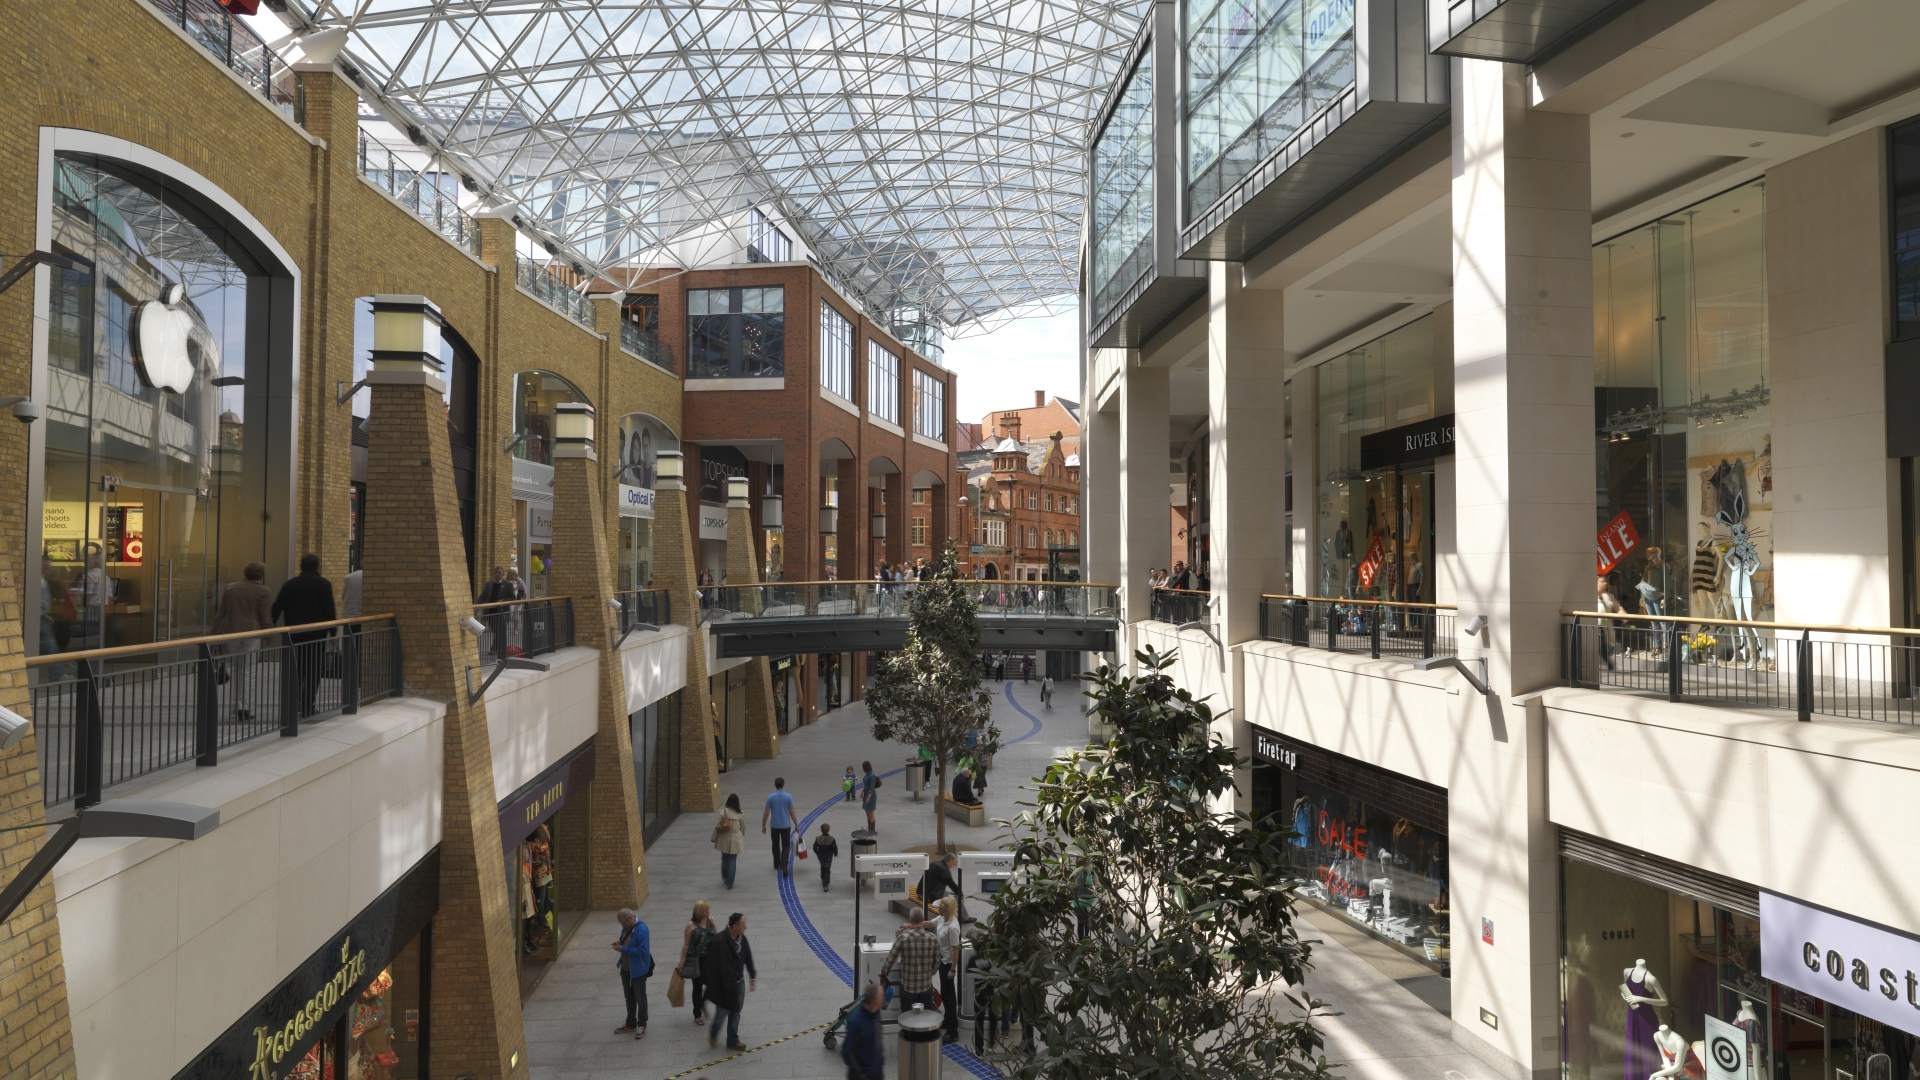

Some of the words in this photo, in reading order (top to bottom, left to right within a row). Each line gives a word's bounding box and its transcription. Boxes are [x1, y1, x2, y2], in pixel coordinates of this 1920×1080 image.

[1406, 431, 1438, 451] RIVER
[1441, 427, 1455, 443] ISL
[628, 489, 648, 507] Optical
[1361, 544, 1384, 586] SALE
[1597, 524, 1635, 570] ALE
[1258, 736, 1297, 771] Firetrap
[1318, 808, 1369, 861] SALE
[1803, 941, 1920, 1010] coast
[249, 936, 366, 1080] Accessorize
